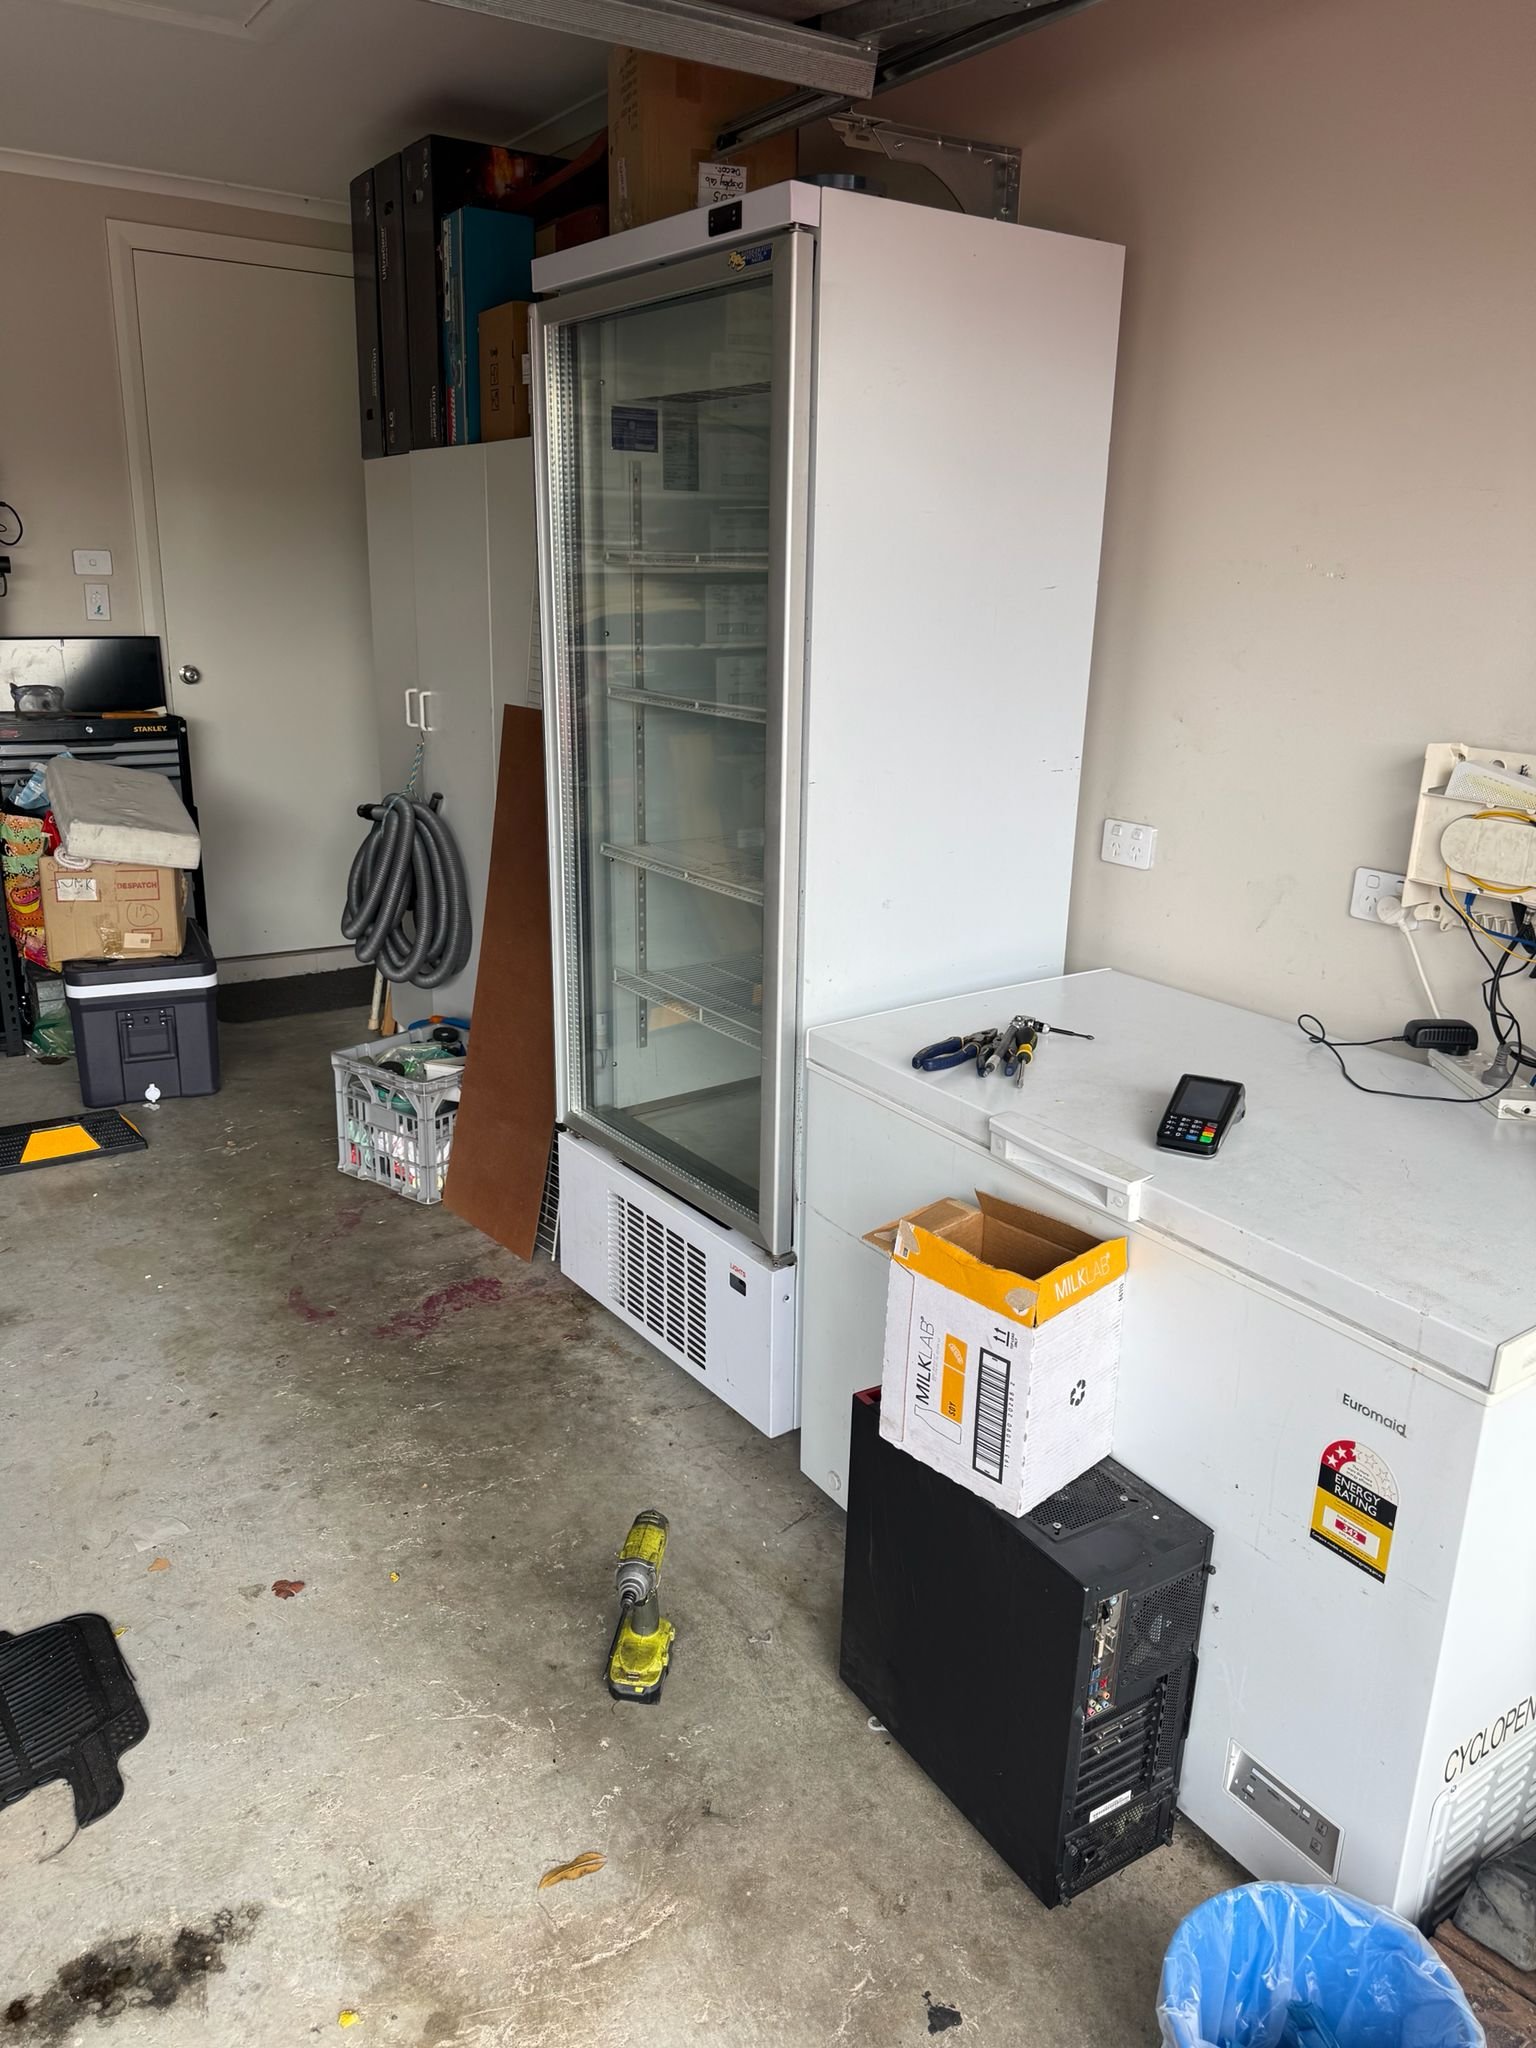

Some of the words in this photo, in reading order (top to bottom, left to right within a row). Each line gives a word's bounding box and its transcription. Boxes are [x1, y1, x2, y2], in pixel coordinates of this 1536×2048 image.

[132, 725, 168, 733] STANLEY
[116, 881, 157, 890] DESPATCH
[730, 1262, 747, 1278] LIGHTS
[1054, 1251, 1111, 1303] MILKLAB
[916, 1315, 935, 1406] MILKLAB
[948, 1401, 957, 1417] SOY
[1342, 1393, 1408, 1439] Euromaid
[1334, 1472, 1380, 1508] ENERGY
[1334, 1483, 1377, 1517] RATING
